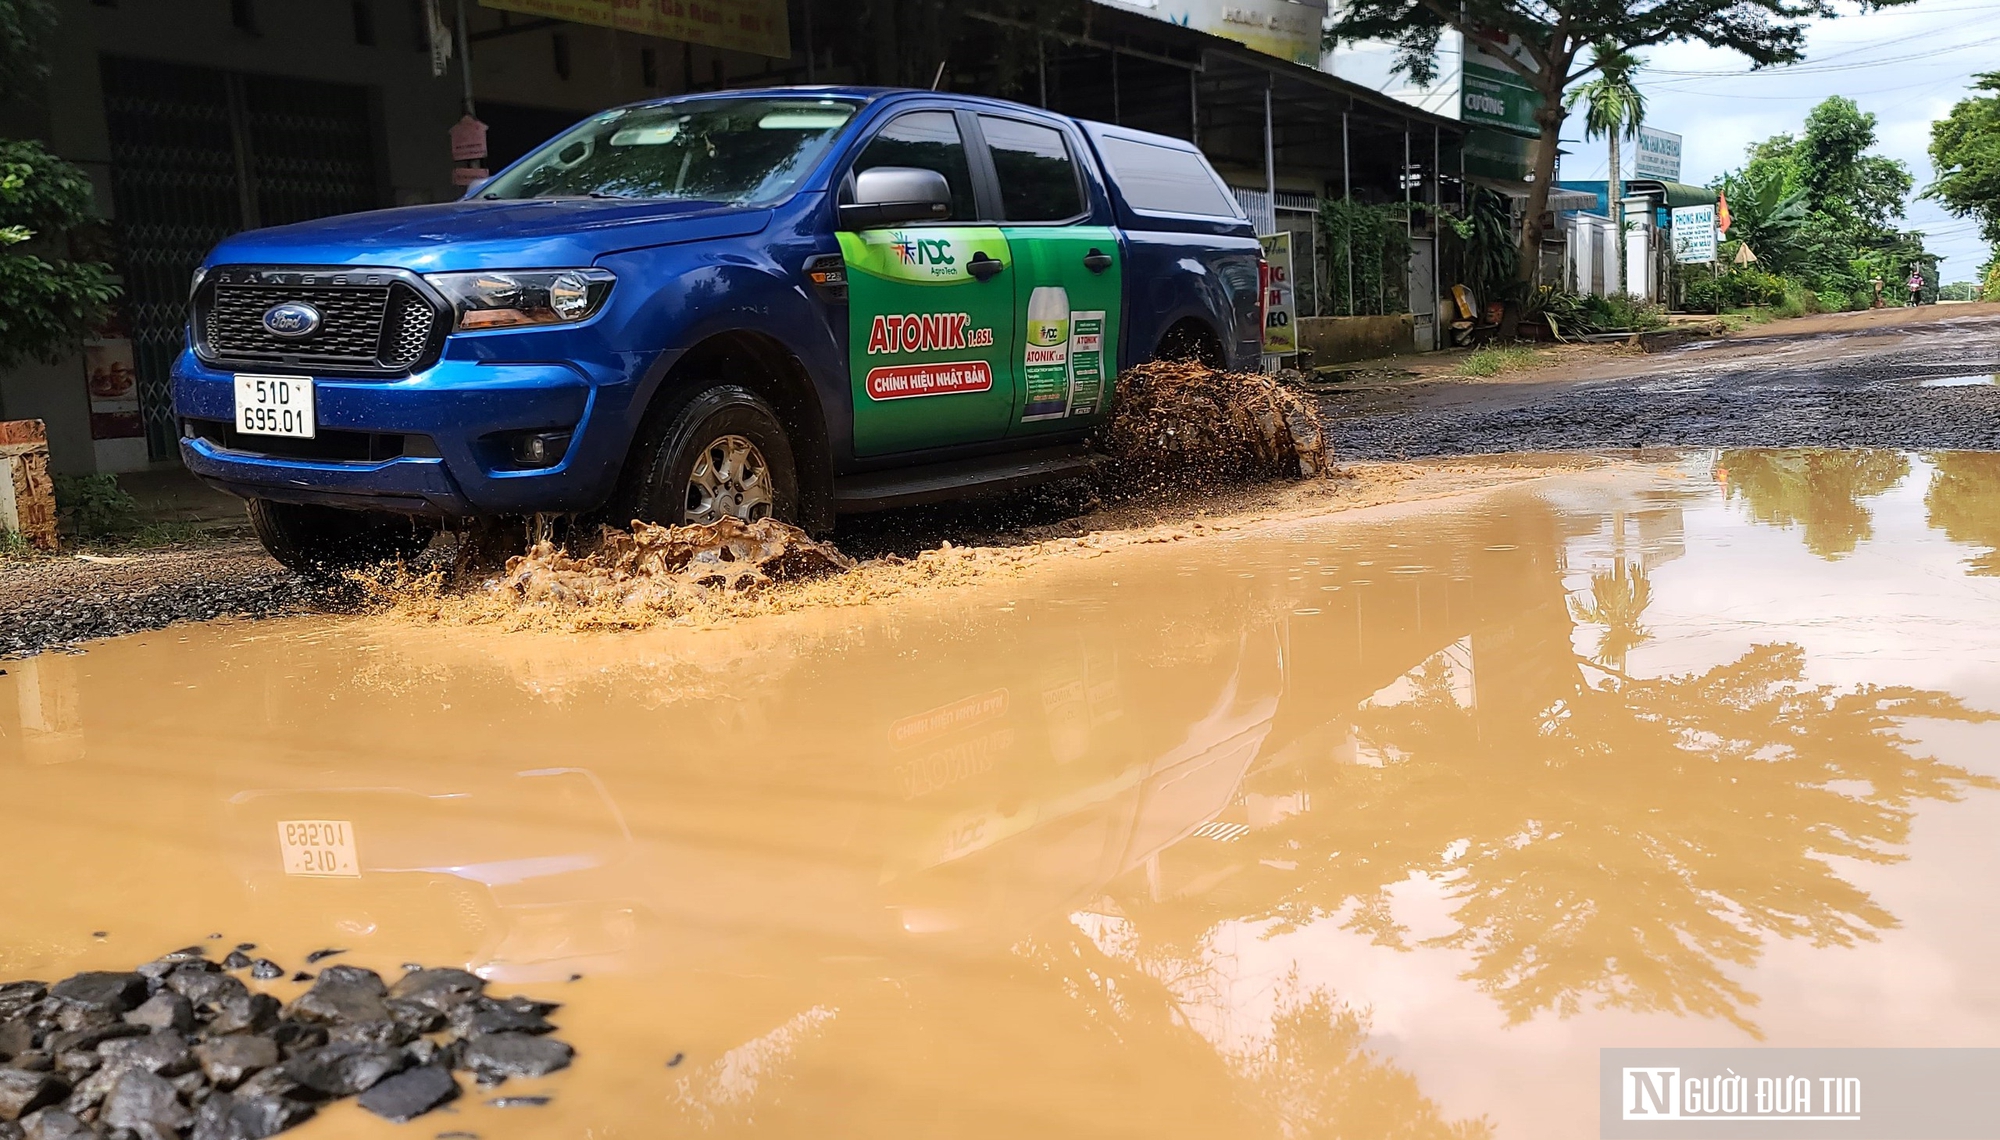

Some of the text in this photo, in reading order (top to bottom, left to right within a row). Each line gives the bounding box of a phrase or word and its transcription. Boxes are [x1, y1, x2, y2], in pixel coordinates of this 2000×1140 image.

[1464, 91, 1505, 116] CƯỜNG
[1675, 209, 1712, 226] PHÒNG KHÁM
[218, 273, 380, 286] RANGER
[930, 266, 958, 277] AgroTech
[270, 309, 302, 329] Ford
[967, 328, 994, 348] 1.8SL
[874, 365, 986, 393] CHÍNH HIỆU NHẬT BẢN
[256, 380, 290, 405] 51D
[244, 407, 304, 434] 695.01
